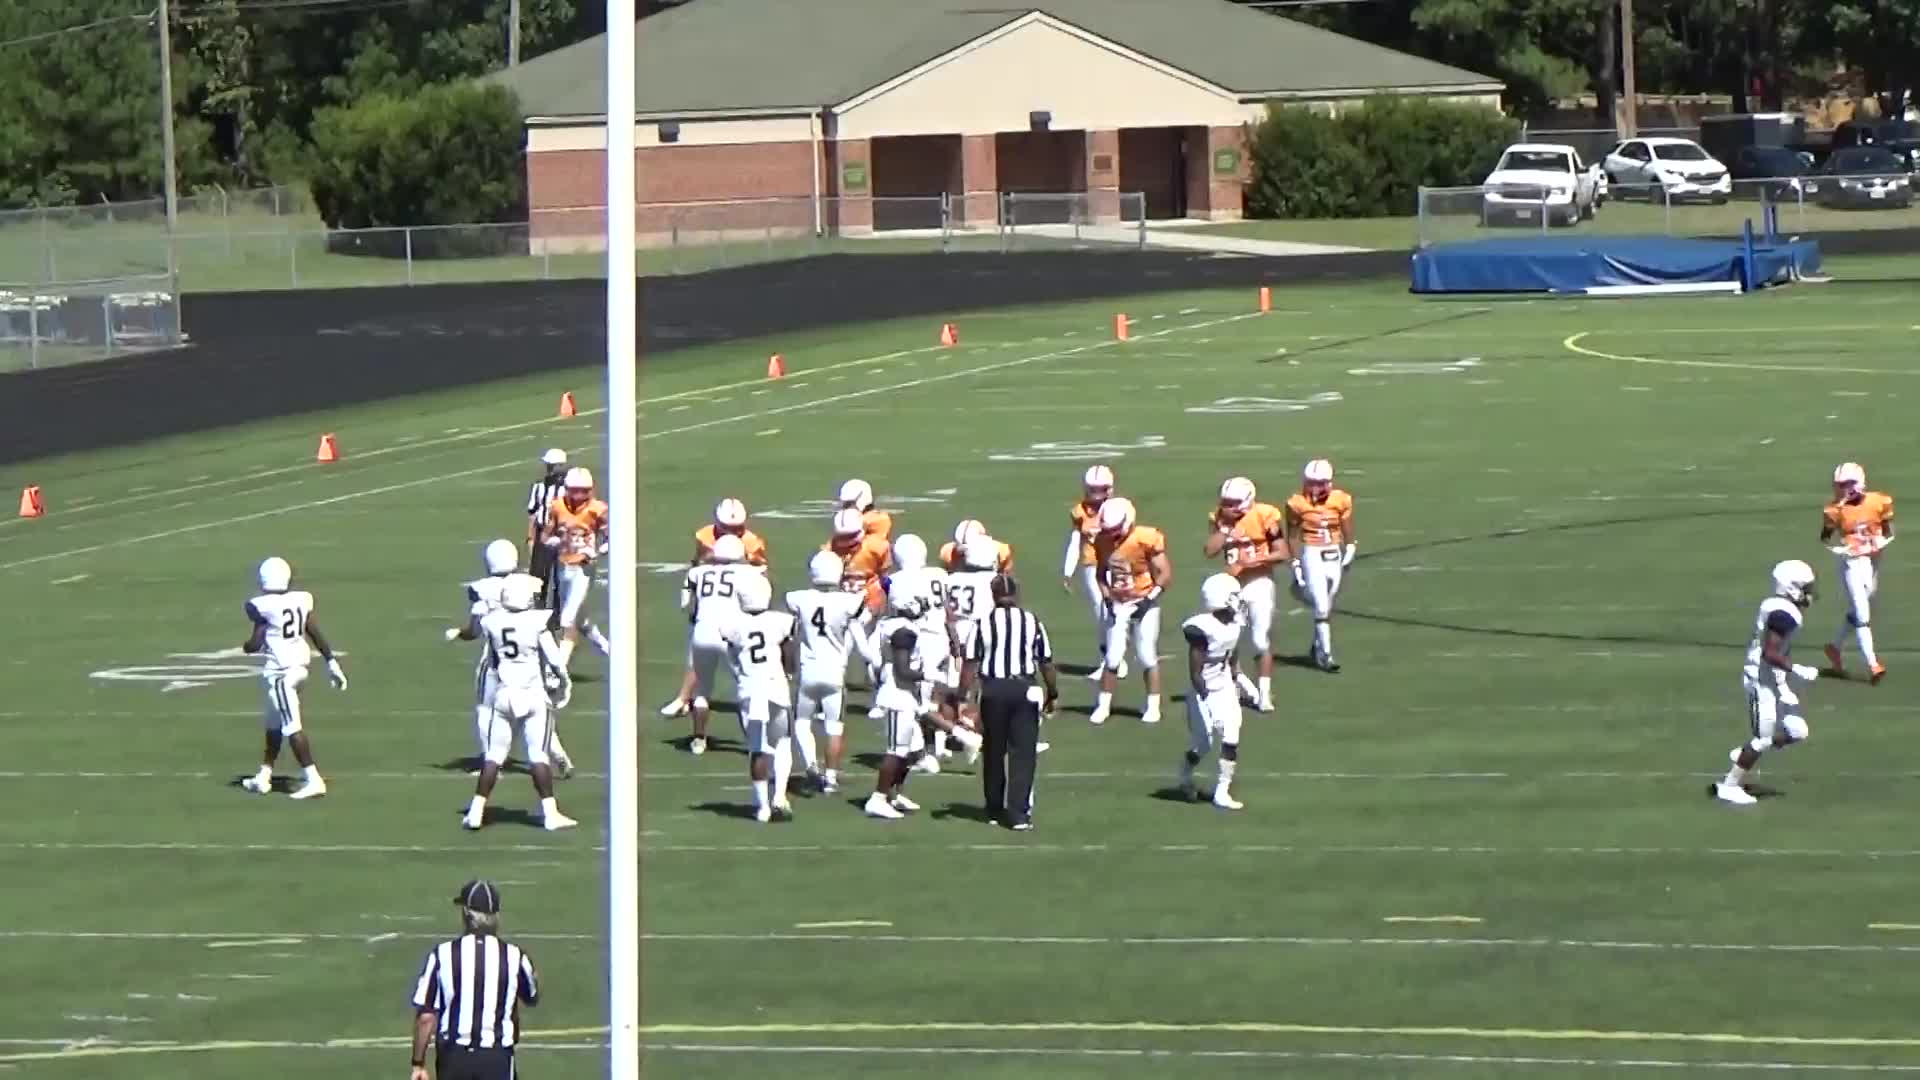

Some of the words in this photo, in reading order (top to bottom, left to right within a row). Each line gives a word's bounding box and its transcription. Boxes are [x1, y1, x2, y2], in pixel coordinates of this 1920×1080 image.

[701, 570, 735, 598] 65
[282, 607, 304, 640] 21
[811, 606, 827, 637] 4
[501, 627, 519, 660] 5
[748, 631, 768, 664] 2
